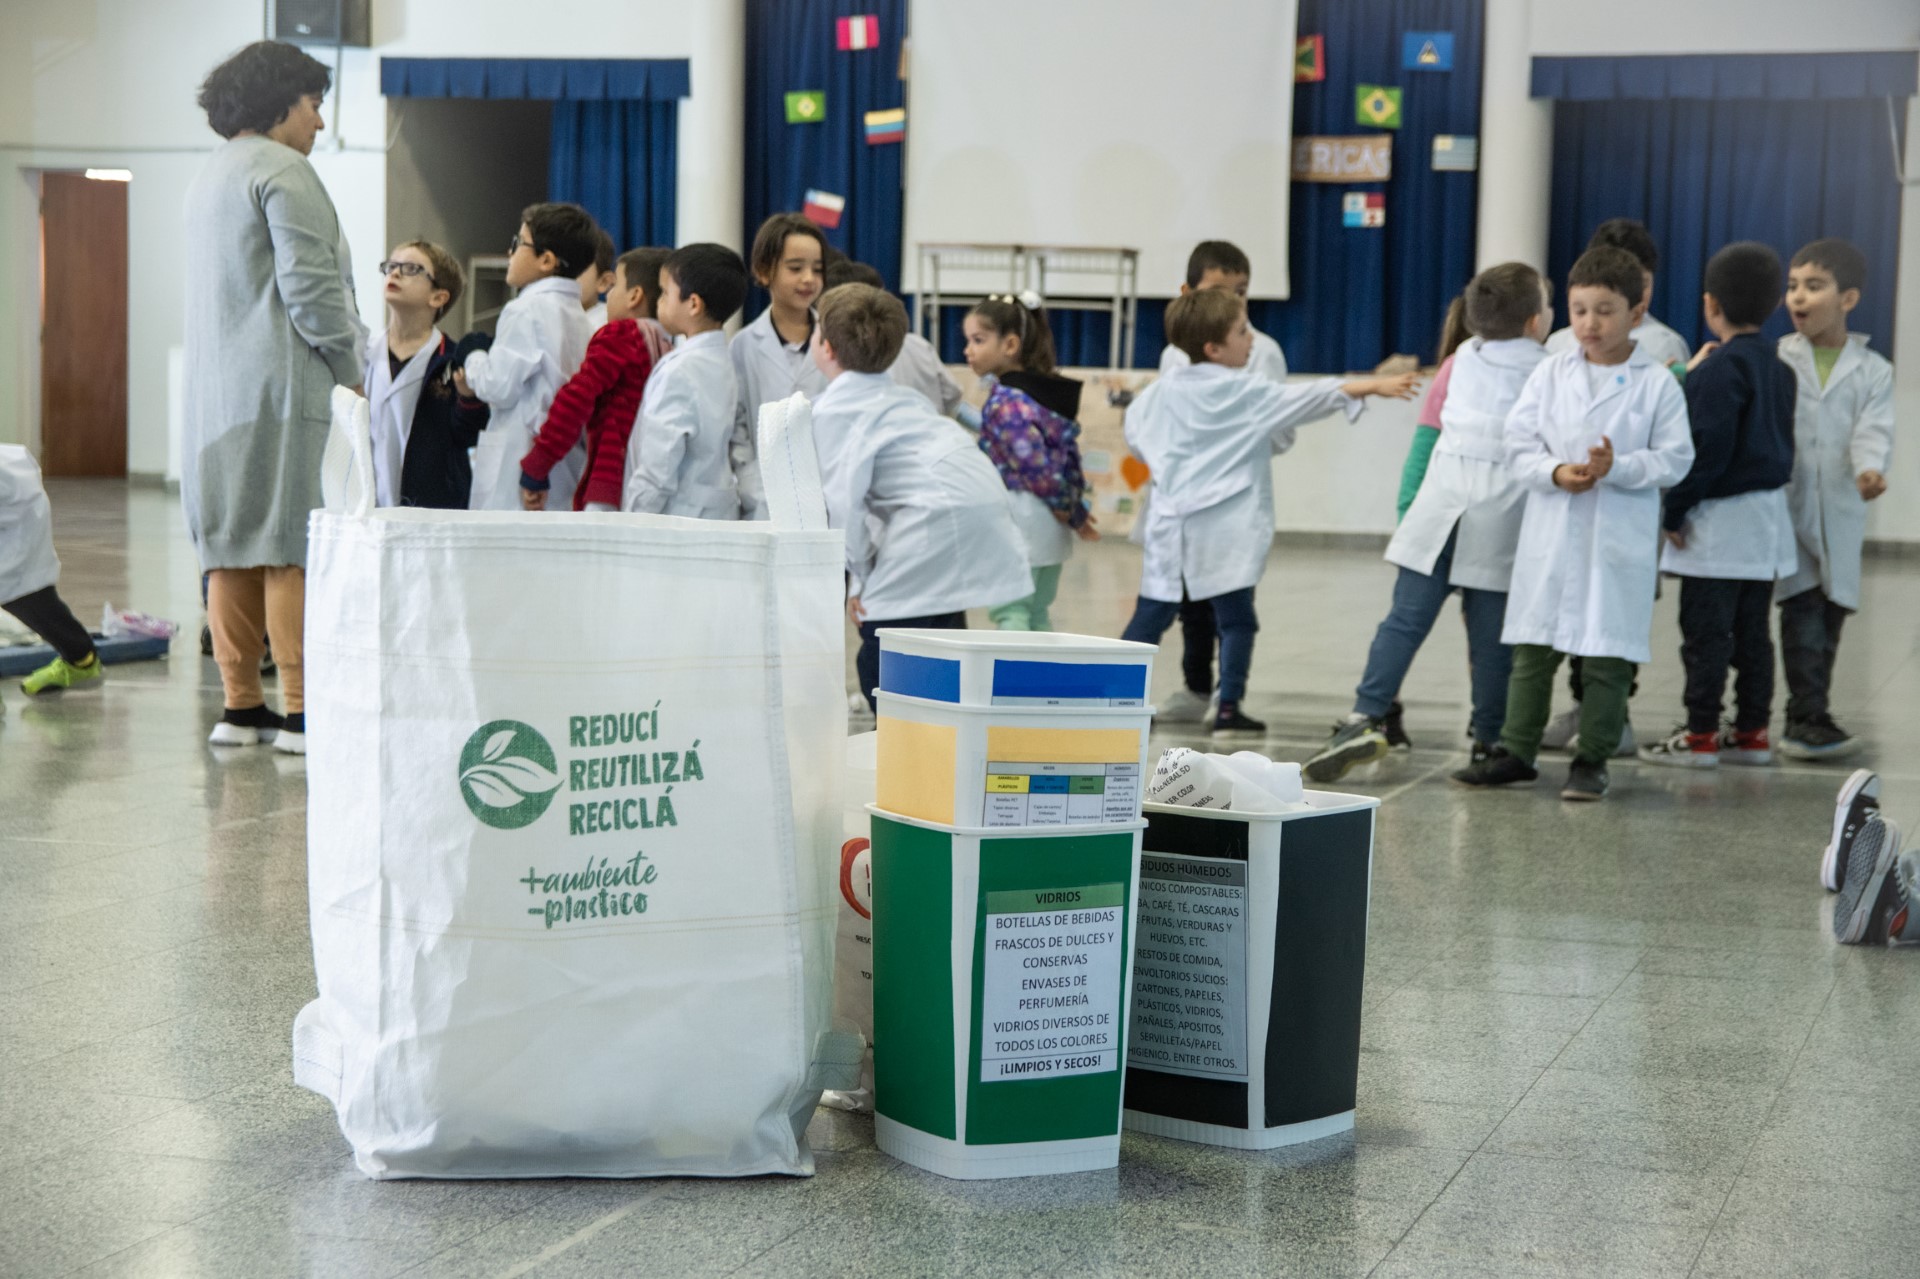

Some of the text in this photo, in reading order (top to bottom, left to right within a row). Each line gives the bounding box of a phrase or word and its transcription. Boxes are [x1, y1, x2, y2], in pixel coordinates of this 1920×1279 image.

[569, 699, 661, 747] REDUCÍ
[569, 739, 704, 791] REUTILIZÁ
[569, 785, 678, 836] RECICLÁ
[1140, 860, 1232, 878] SIDUOS HÚMEDOS
[1035, 891, 1081, 904] VIDRIOS
[1141, 881, 1243, 899] NICOS COMPOSTABLES:
[1138, 898, 1239, 917] BA, CAFÉ, TÉ, CASCARAS
[996, 911, 1115, 929] BOTELLAS DE BEBIDAS
[1141, 915, 1175, 929] FRUTAS,
[1177, 919, 1224, 933] VERDURAS
[1226, 923, 1232, 933] Y
[995, 932, 1114, 950] FRASCOS DE DULCES Y
[1150, 932, 1208, 947] HUEVOS, ETC.
[1023, 954, 1088, 969] CONSERVAS
[1137, 949, 1223, 968] RESTOS DE COMIDA,
[1022, 975, 1087, 990] ENVASES DE
[1134, 966, 1228, 986] ENVOLTORIOS SUCIOS:
[1019, 992, 1089, 1010] PERFUMERÍA
[1136, 983, 1225, 1003] CARTONES, PAPELES,
[1138, 999, 1224, 1020] PLÁSTICOS, VIDRIOS,
[993, 1013, 1110, 1033] VIDRIOS DIVERSOS DE
[1138, 1015, 1224, 1036] PAÑALES, APOSITOS,
[995, 1033, 1108, 1053] TODOS LOS COLORES
[1140, 1032, 1222, 1051] SERVILLETAS/PAPEL
[1000, 1055, 1101, 1075] ¡LIMPIOS Y SECOS!
[1128, 1047, 1237, 1069] HIGIENICO, ENTRE OTROS.
